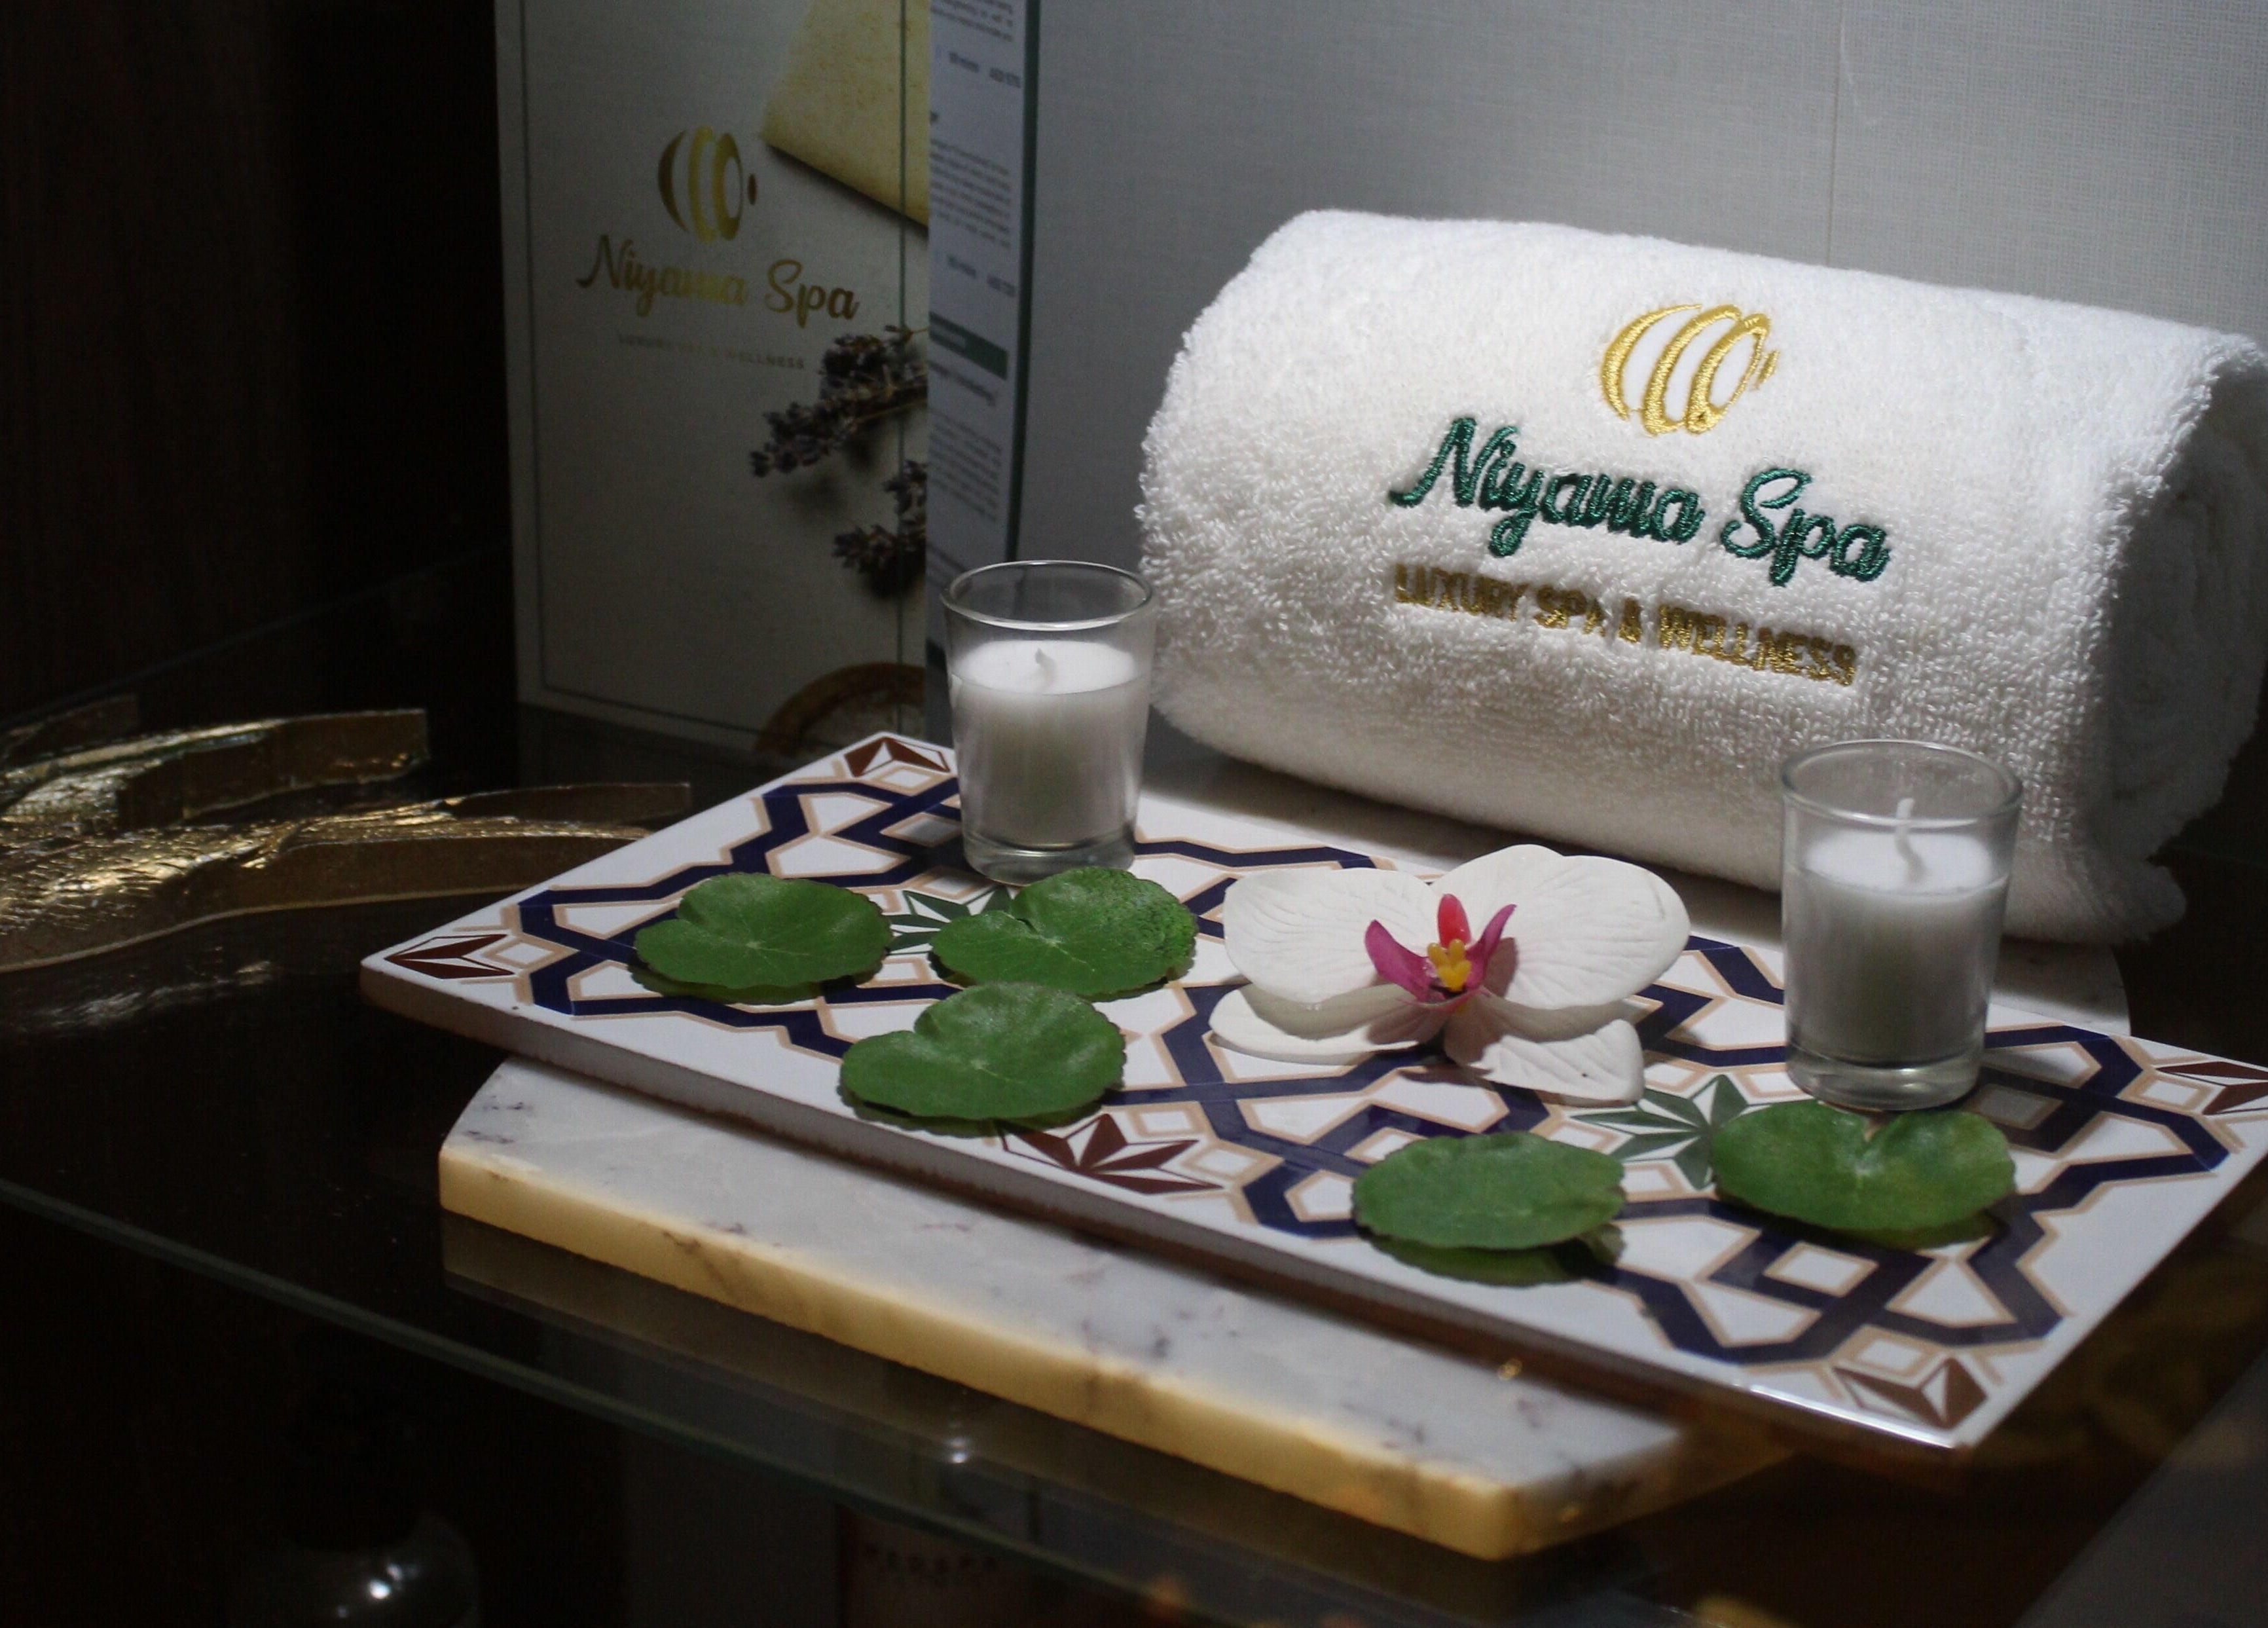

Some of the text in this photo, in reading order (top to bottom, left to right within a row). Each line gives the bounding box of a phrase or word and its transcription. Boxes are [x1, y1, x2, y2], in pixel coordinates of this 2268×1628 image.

[576, 234, 747, 317] Niyama
[763, 259, 860, 327] Spa
[1388, 416, 1891, 587] Niyama Spa
[1394, 563, 1530, 622] LUXURY
[1534, 584, 1605, 637] SPA
[1658, 604, 1857, 686] WELLNESS
